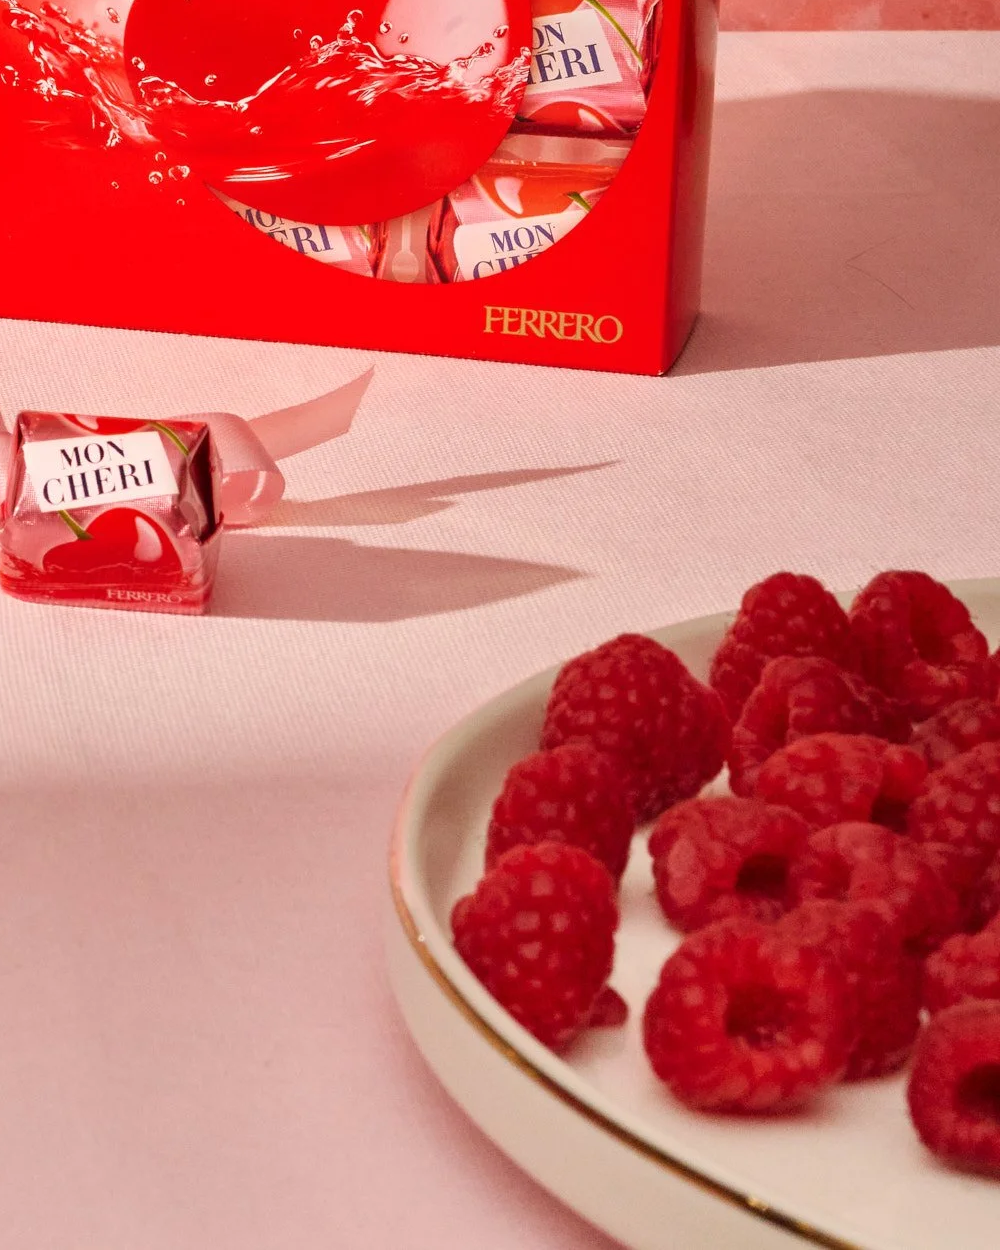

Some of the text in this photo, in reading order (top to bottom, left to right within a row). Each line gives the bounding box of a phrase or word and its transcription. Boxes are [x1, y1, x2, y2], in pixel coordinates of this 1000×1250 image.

[532, 21, 566, 50] ON
[526, 43, 605, 85] ÉRI
[488, 222, 556, 254] MON
[483, 305, 624, 344] FERRERO
[60, 439, 126, 470] MON
[106, 589, 182, 604] FERRERO
